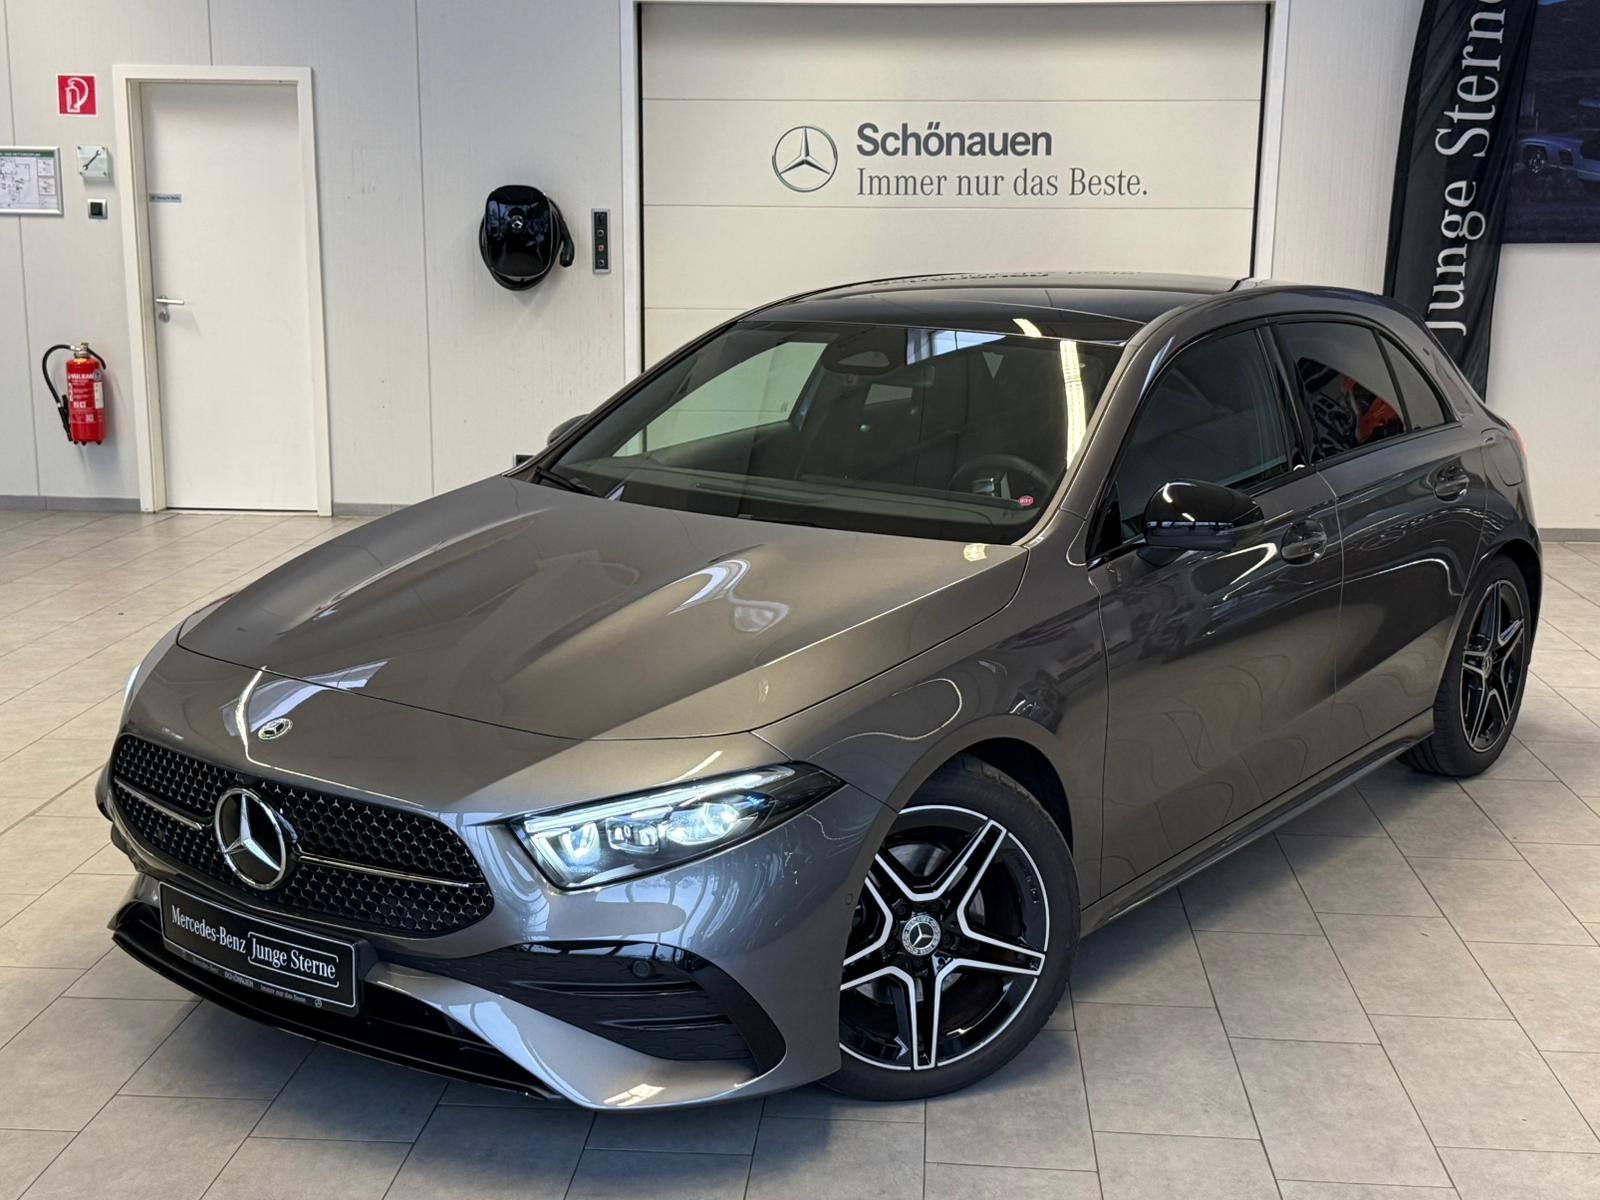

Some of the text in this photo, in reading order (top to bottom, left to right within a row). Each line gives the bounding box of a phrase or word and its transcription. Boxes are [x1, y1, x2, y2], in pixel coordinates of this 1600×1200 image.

[857, 121, 1052, 157] Schönauen
[857, 167, 1148, 196] Immer nur das Beste.
[1425, 0, 1506, 336] Junge Stern
[171, 904, 246, 954] Mercedes-Benz
[251, 938, 287, 968] Junge
[291, 950, 336, 979] Sterne
